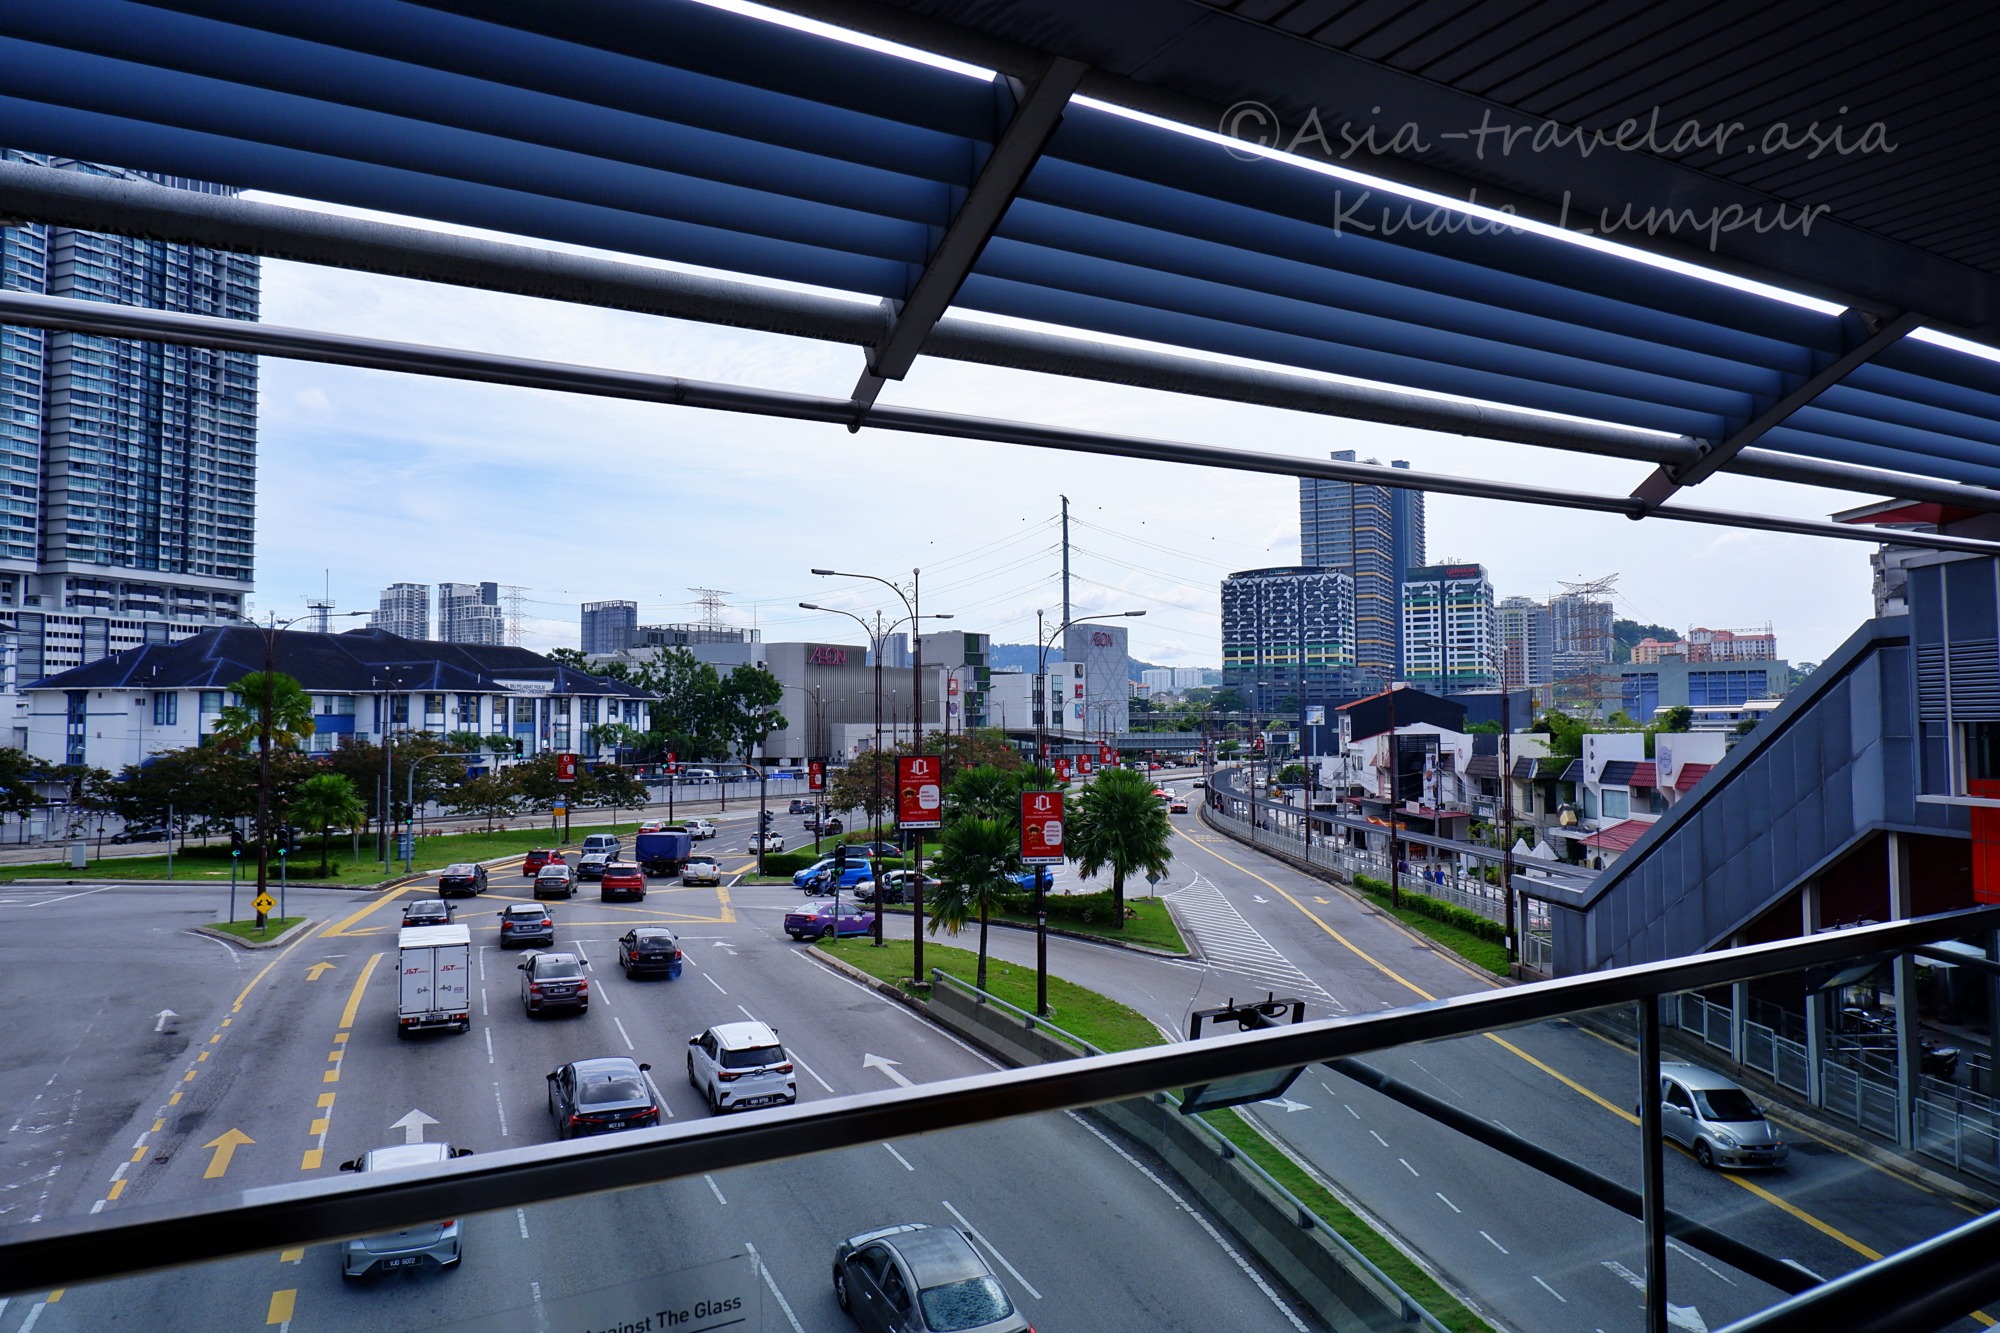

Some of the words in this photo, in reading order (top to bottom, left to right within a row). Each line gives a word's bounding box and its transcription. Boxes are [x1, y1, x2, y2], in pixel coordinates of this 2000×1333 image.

[1446, 567, 1477, 575] GERAKAN
[1090, 631, 1114, 647] AEON
[809, 647, 847, 665] AEON
[440, 964, 456, 972] J&T
[402, 1257, 416, 1265] 5072
[656, 1309, 690, 1328] The
[694, 1297, 742, 1318] Glass
